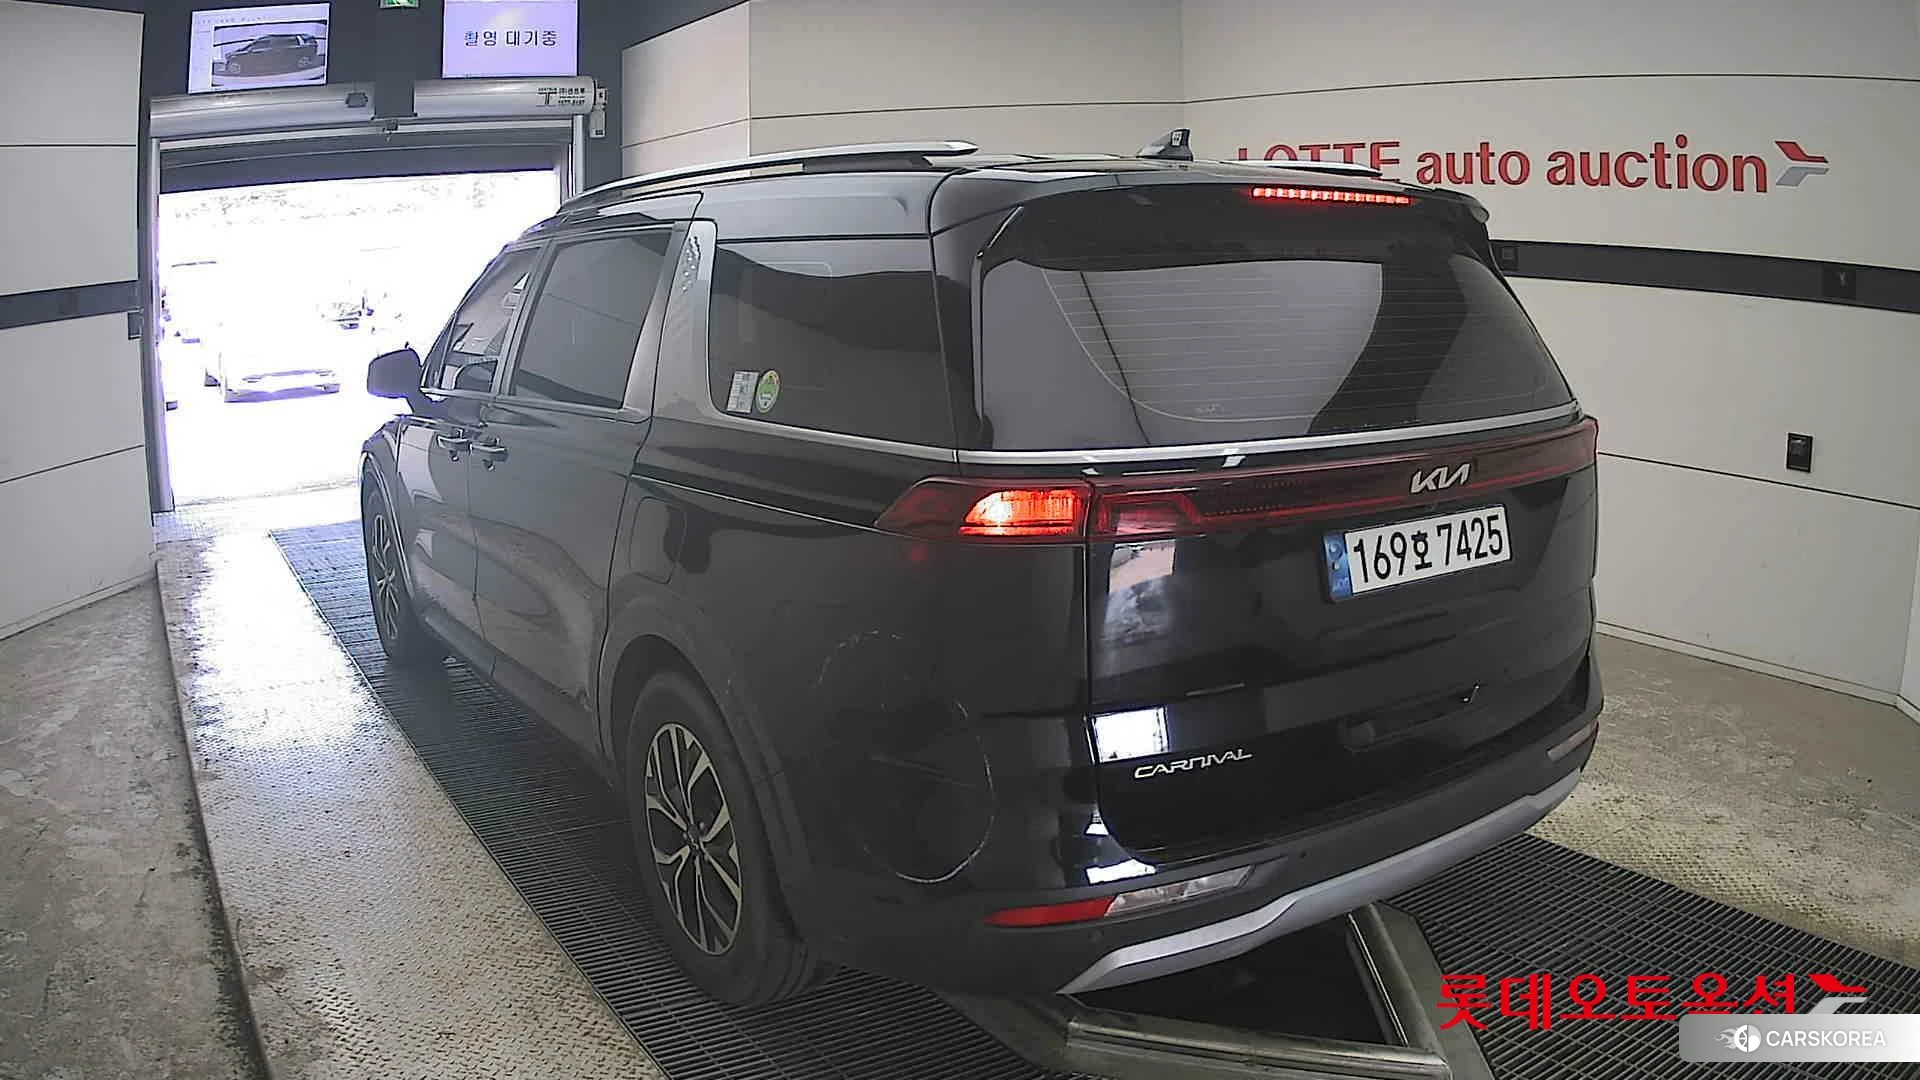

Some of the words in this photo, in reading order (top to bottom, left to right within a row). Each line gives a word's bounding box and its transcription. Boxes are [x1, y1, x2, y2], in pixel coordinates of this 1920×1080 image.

[505, 29, 558, 47] 대기중
[1237, 141, 1400, 182] TTE
[1416, 141, 1530, 186] auto
[1546, 134, 1768, 193] auction
[1133, 748, 1253, 779] CARNIVAL
